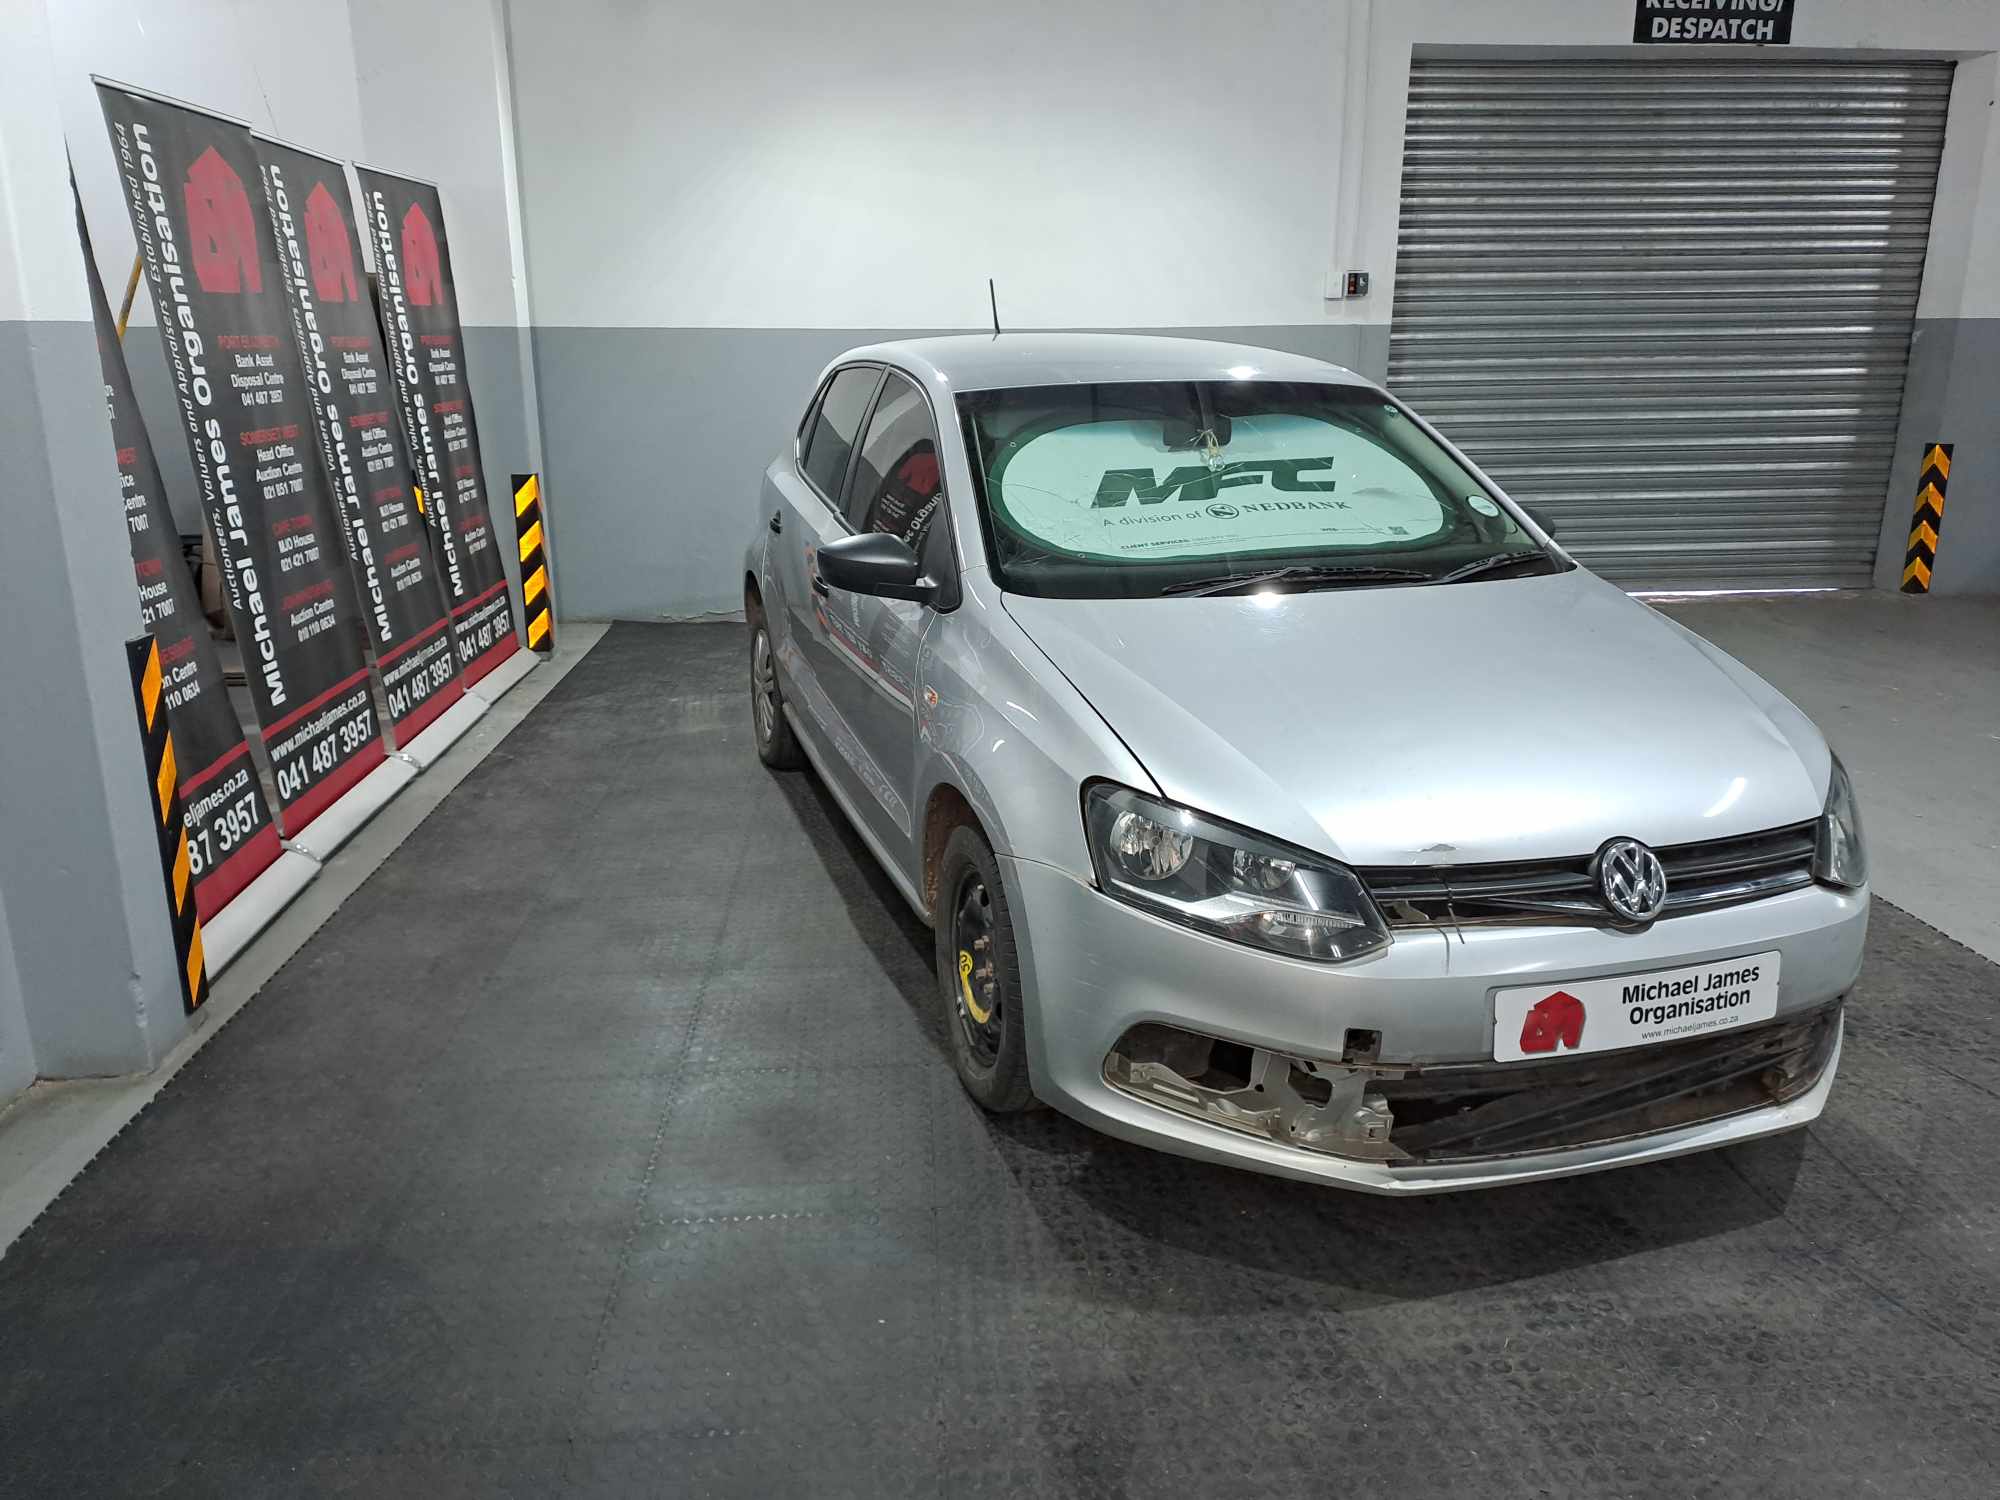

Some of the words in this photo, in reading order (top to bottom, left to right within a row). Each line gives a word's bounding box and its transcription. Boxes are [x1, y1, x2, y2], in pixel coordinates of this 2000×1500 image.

[1651, 17, 1775, 41] DESPATCH
[113, 121, 135, 169] 1964
[126, 174, 162, 283] Established
[132, 123, 212, 406] Organisation
[269, 164, 332, 394] Organisation
[372, 191, 419, 385] Organisation
[158, 299, 190, 395] Appraisers
[181, 397, 199, 433] and
[413, 393, 441, 484] James
[194, 438, 216, 501] Valuers
[204, 418, 248, 546] James
[326, 404, 361, 510] James
[1091, 456, 1336, 508] MFC
[431, 490, 465, 597] Michael
[1103, 517, 1115, 528] A
[1119, 510, 1182, 527] division
[1185, 509, 1203, 522] of
[1242, 500, 1353, 513] NEDBANK
[138, 581, 168, 602] House
[351, 518, 393, 642] Michael
[235, 557, 287, 707] Michael
[458, 633, 478, 662] 041
[477, 622, 493, 649] 487
[171, 660, 198, 684] Centre
[388, 684, 412, 718] 041
[411, 669, 431, 701] 487
[429, 652, 453, 687] 3957
[270, 690, 367, 762] www.michaeljames.co.za
[277, 755, 310, 800] 041
[312, 733, 338, 774] 487
[339, 708, 373, 754] 3957
[213, 791, 260, 851] 3957
[1622, 976, 1698, 1004] Michael
[1703, 966, 1760, 992] James
[1629, 989, 1751, 1025] Organisation
[1641, 1015, 1740, 1040] www.michaeljames.co.za
